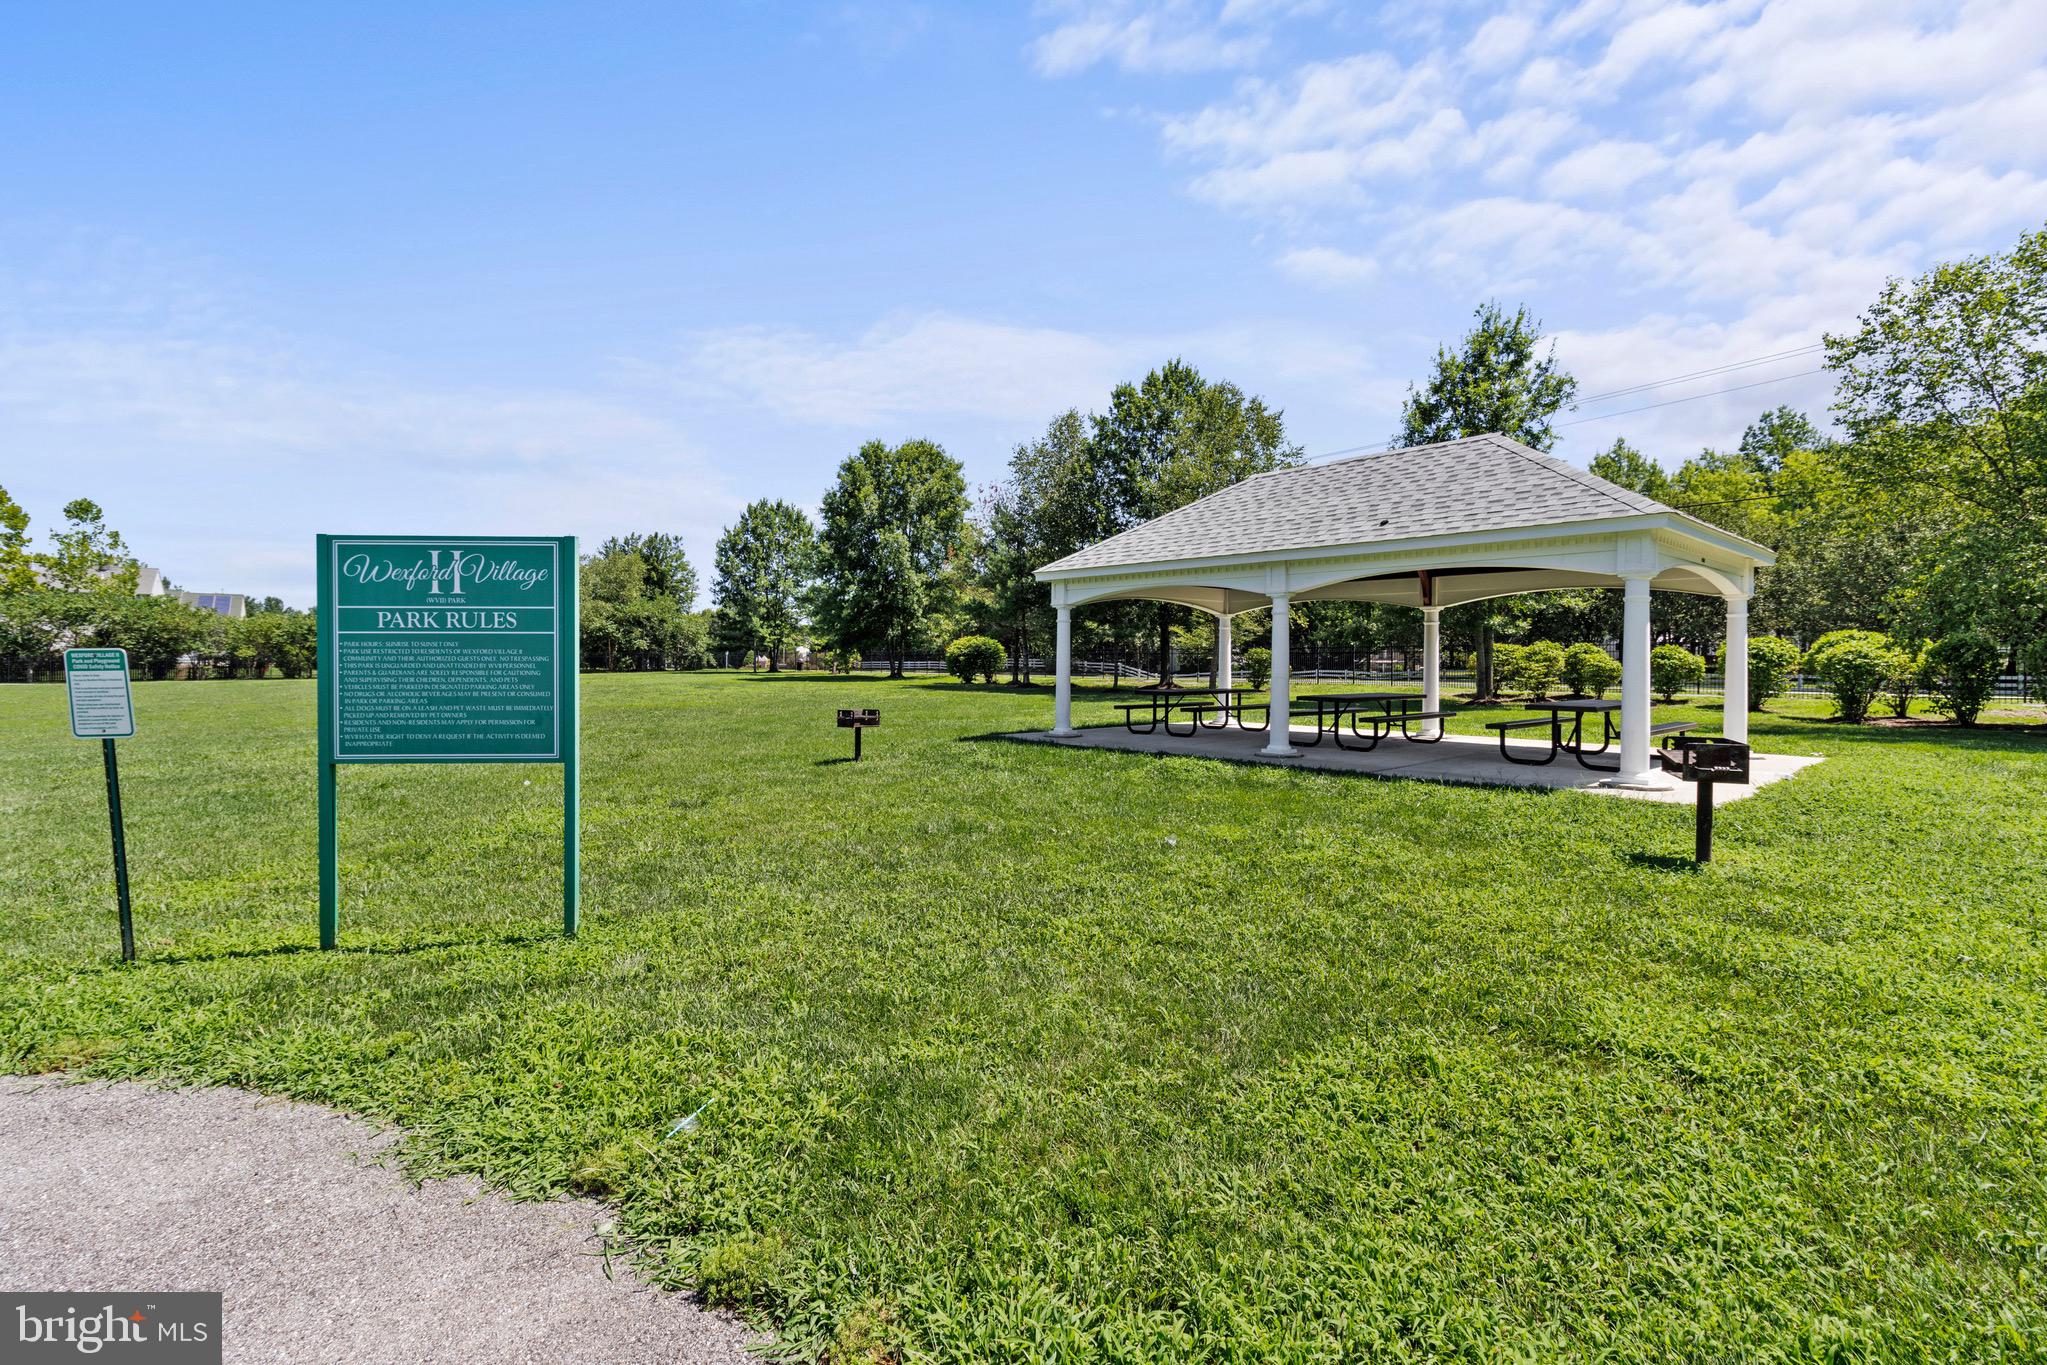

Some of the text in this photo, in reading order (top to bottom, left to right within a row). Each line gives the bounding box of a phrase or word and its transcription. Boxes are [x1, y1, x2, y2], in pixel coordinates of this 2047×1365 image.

[343, 553, 548, 591] Wexford Village
[376, 612, 517, 629] PARK RULES
